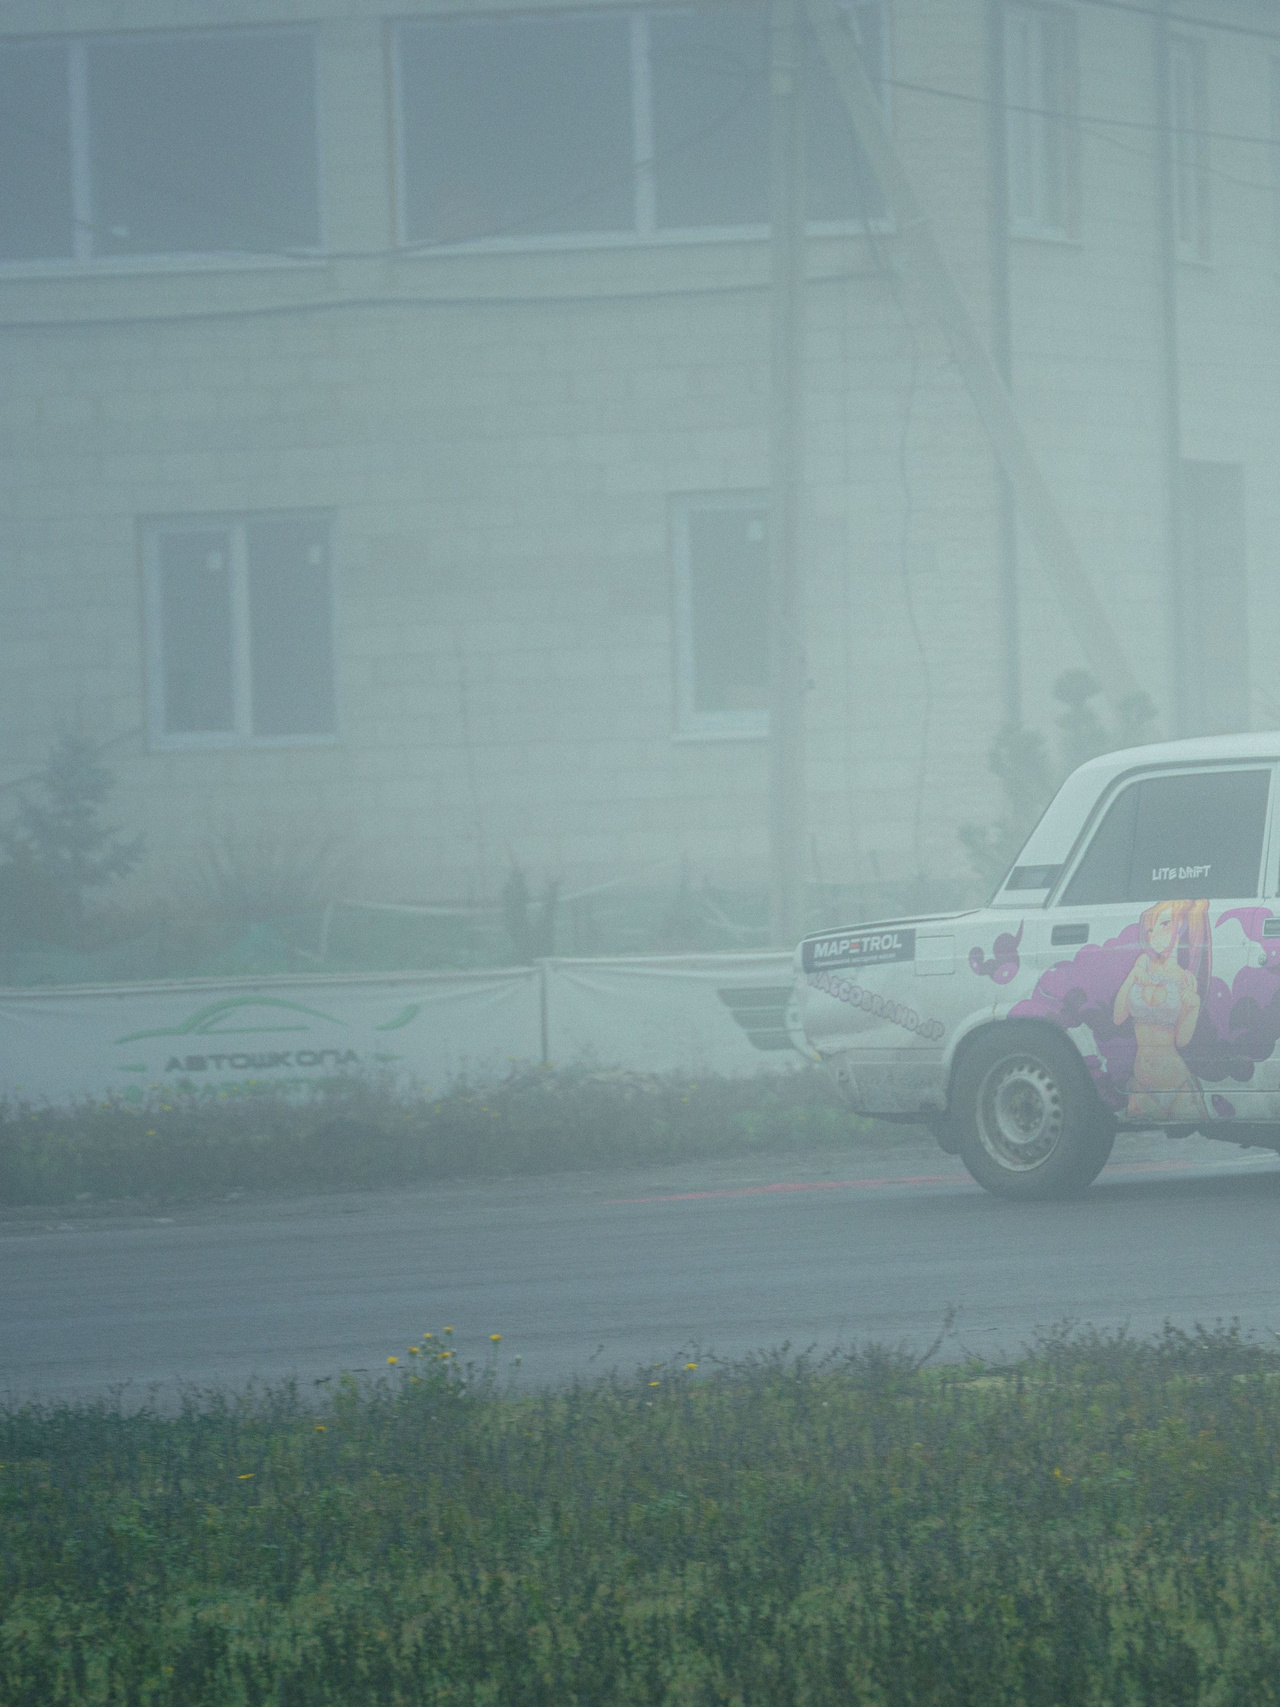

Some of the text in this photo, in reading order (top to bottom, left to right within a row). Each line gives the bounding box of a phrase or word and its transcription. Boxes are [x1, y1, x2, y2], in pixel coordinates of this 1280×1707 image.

[1152, 864, 1211, 880] LITE DRIFT
[814, 934, 902, 958] MAPETROL
